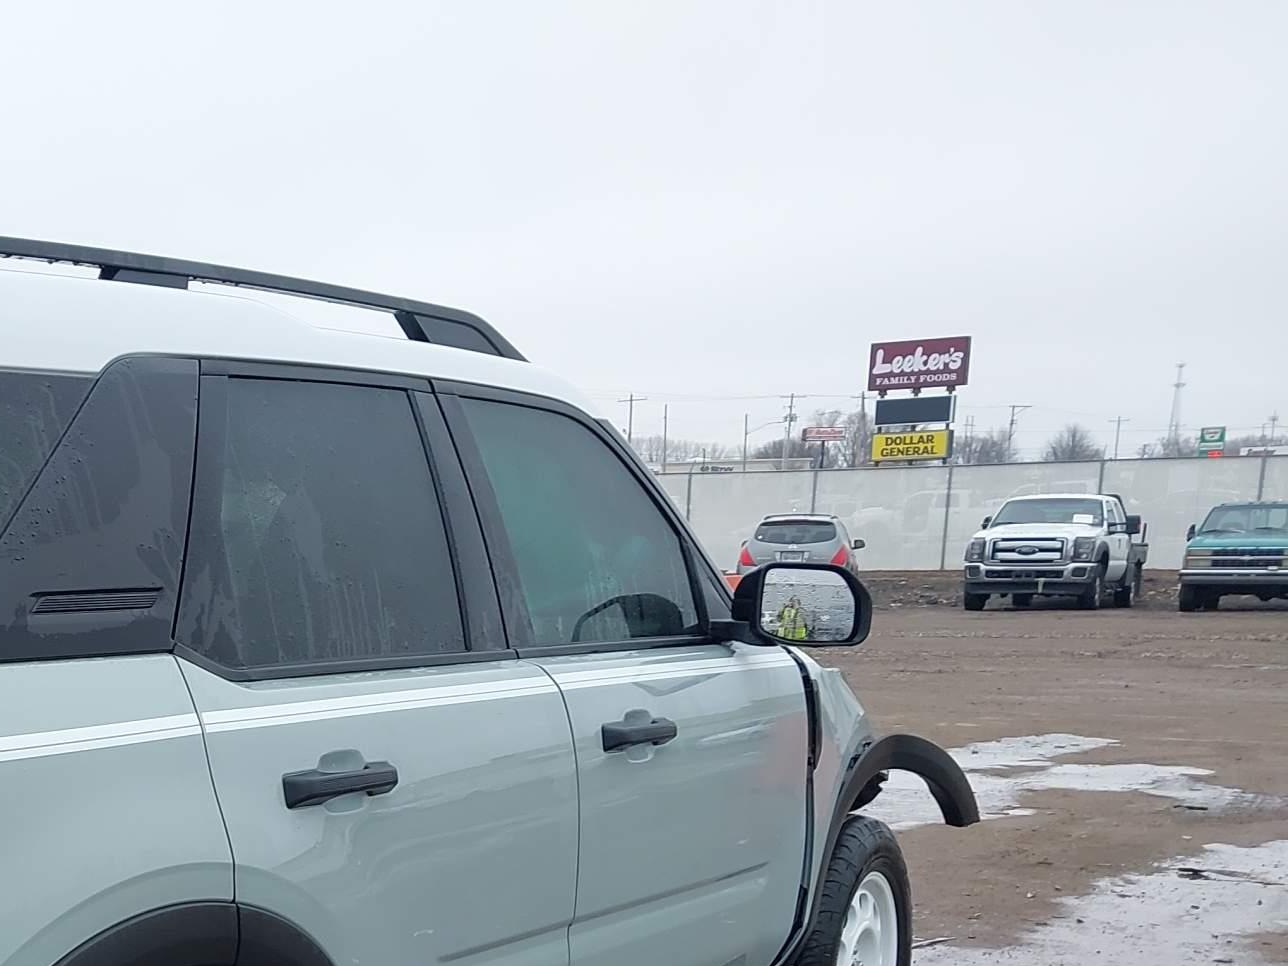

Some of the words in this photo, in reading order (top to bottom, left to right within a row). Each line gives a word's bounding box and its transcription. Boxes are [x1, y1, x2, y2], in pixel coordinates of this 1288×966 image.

[872, 346, 964, 374] Leeker's
[876, 376, 917, 385] FAMILY
[920, 373, 957, 382] FOODS
[885, 435, 935, 446] DOLLAR
[880, 446, 937, 457] GENERAL
